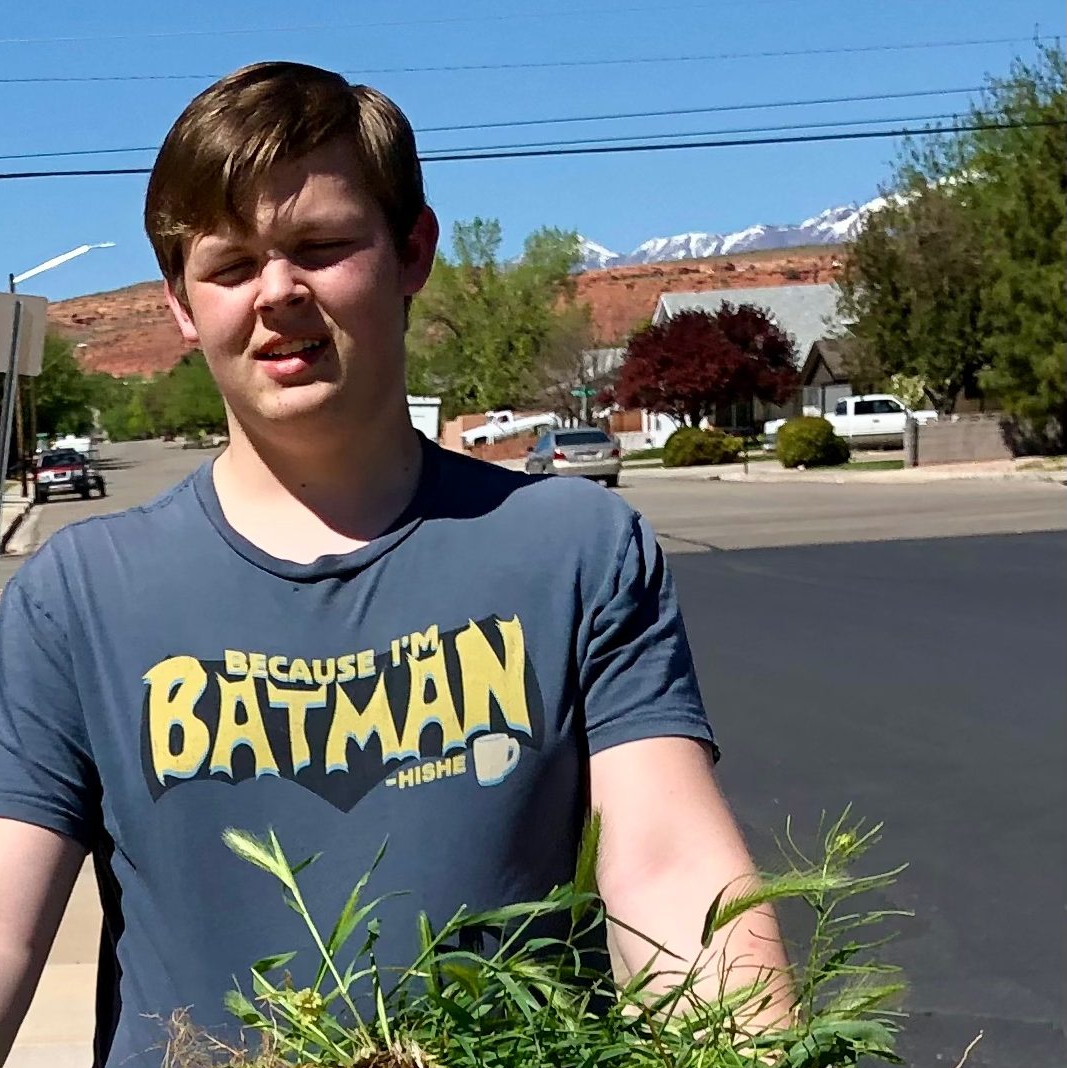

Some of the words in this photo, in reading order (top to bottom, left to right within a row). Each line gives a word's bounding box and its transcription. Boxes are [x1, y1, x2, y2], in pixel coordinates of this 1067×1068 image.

[142, 613, 533, 787] BATMAN
[224, 648, 377, 686] BECAUSE
[391, 624, 439, 668] I'M
